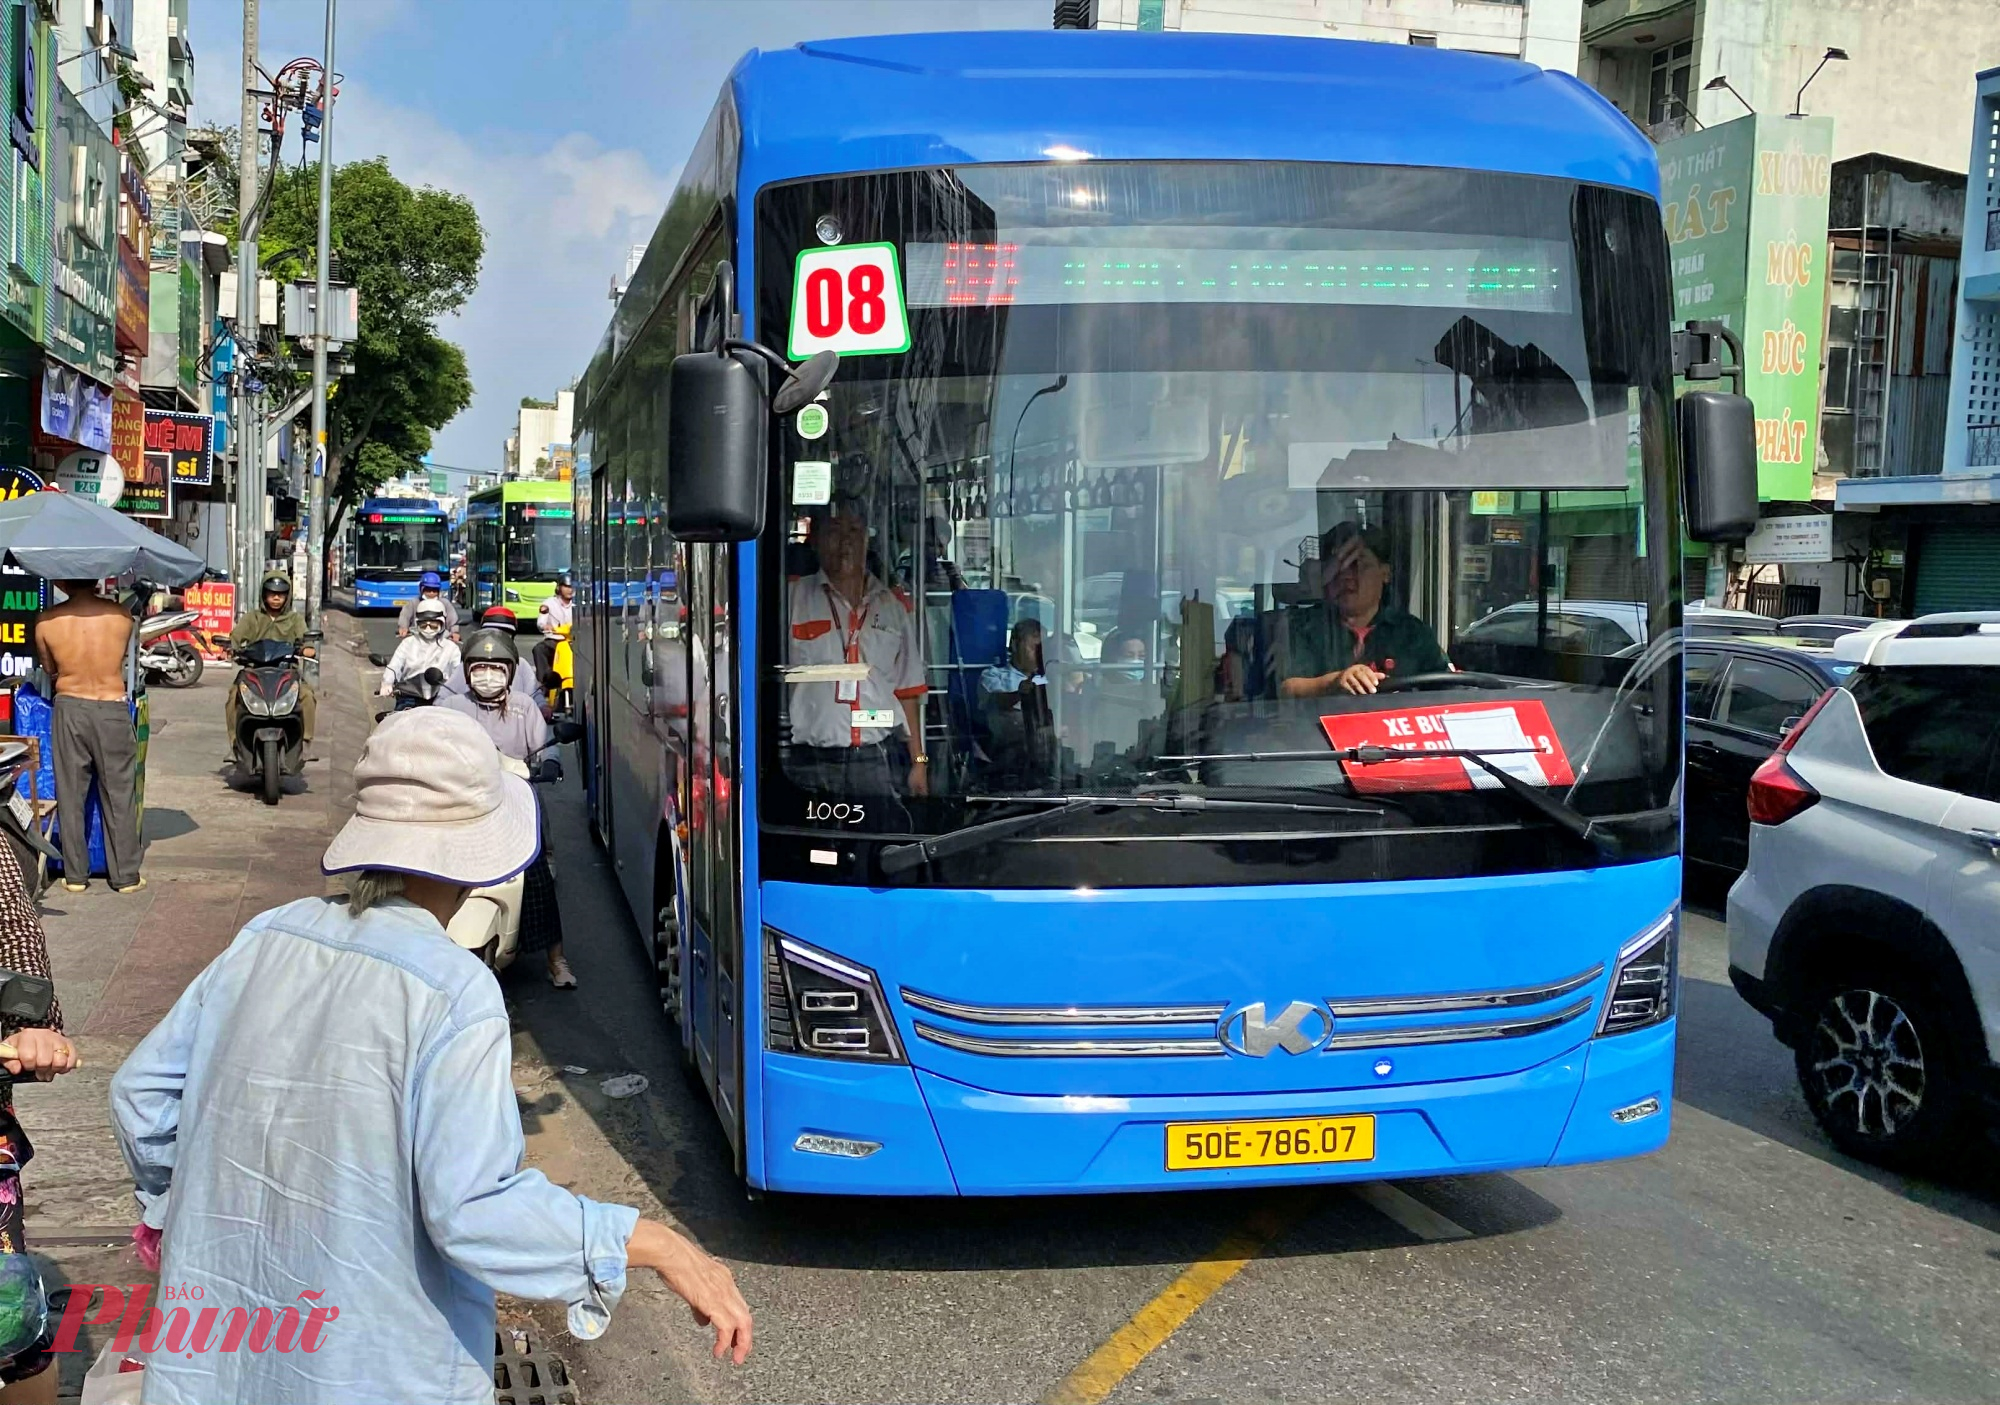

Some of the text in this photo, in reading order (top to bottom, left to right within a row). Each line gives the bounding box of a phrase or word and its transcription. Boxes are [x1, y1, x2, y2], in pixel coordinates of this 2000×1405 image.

[1757, 137, 1829, 198] XƯỞNG
[1764, 228, 1812, 298] MỘC
[805, 264, 886, 338] 08
[1761, 319, 1807, 376] ĐỨC
[79, 481, 97, 493] 243
[2, 590, 38, 611] ALU
[213, 592, 232, 607] SALE
[0, 623, 26, 644] LE
[1382, 717, 1415, 737] XE
[805, 800, 865, 823] 1003
[1186, 1125, 1356, 1160] 50E-786.07
